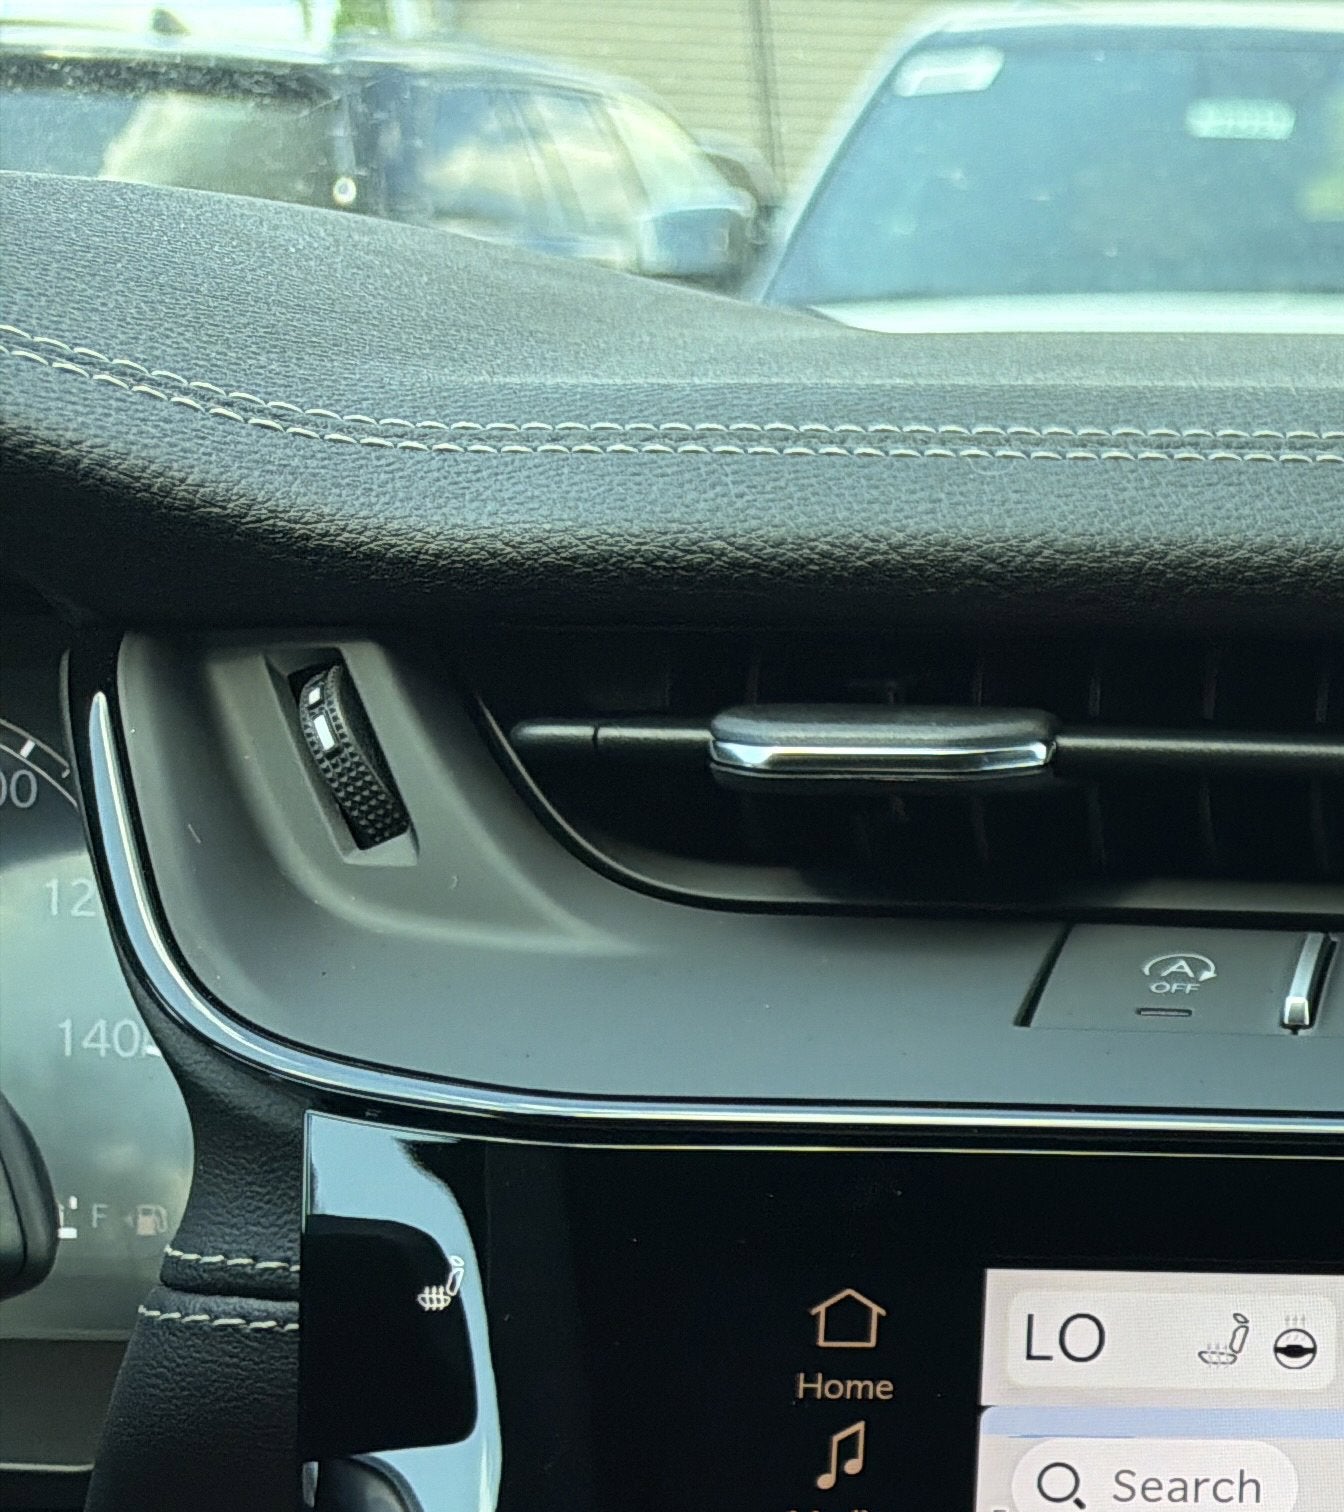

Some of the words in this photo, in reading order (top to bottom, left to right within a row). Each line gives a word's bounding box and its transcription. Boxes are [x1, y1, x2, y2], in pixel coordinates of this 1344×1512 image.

[1149, 981, 1201, 995] OFF
[58, 1018, 140, 1058] 140
[91, 1203, 108, 1228] F
[1025, 1312, 1106, 1363] LO
[796, 1373, 894, 1401] Home
[1112, 1469, 1262, 1504] Search
